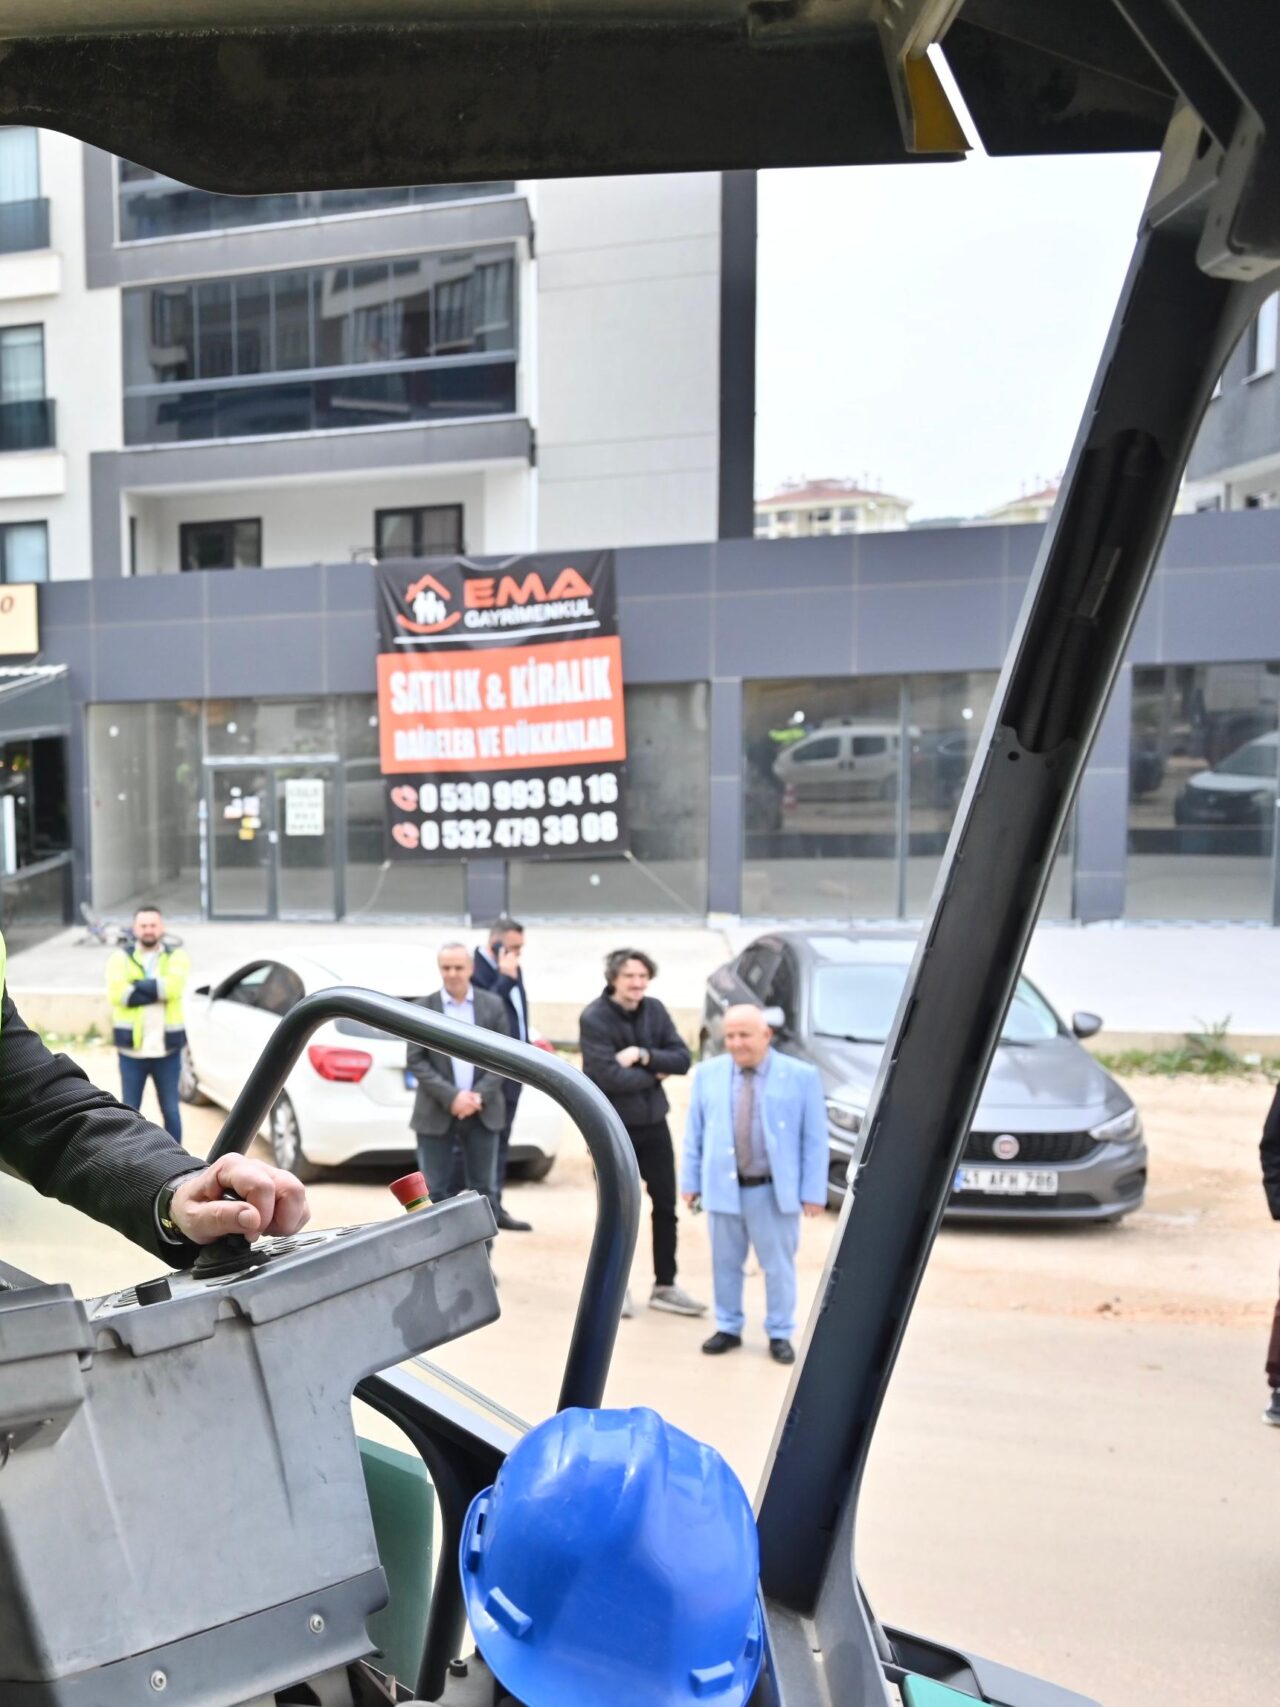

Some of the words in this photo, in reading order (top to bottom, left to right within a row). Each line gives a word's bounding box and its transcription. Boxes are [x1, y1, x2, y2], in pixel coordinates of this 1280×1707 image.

[464, 567, 593, 608] EMA
[390, 668, 482, 714] SATILIK
[486, 673, 506, 711] &
[510, 656, 613, 709] KİRALIK
[419, 783, 438, 813] 0
[440, 781, 491, 812] 530
[585, 772, 619, 804] 16
[421, 820, 440, 850] 0
[442, 818, 492, 850] 532
